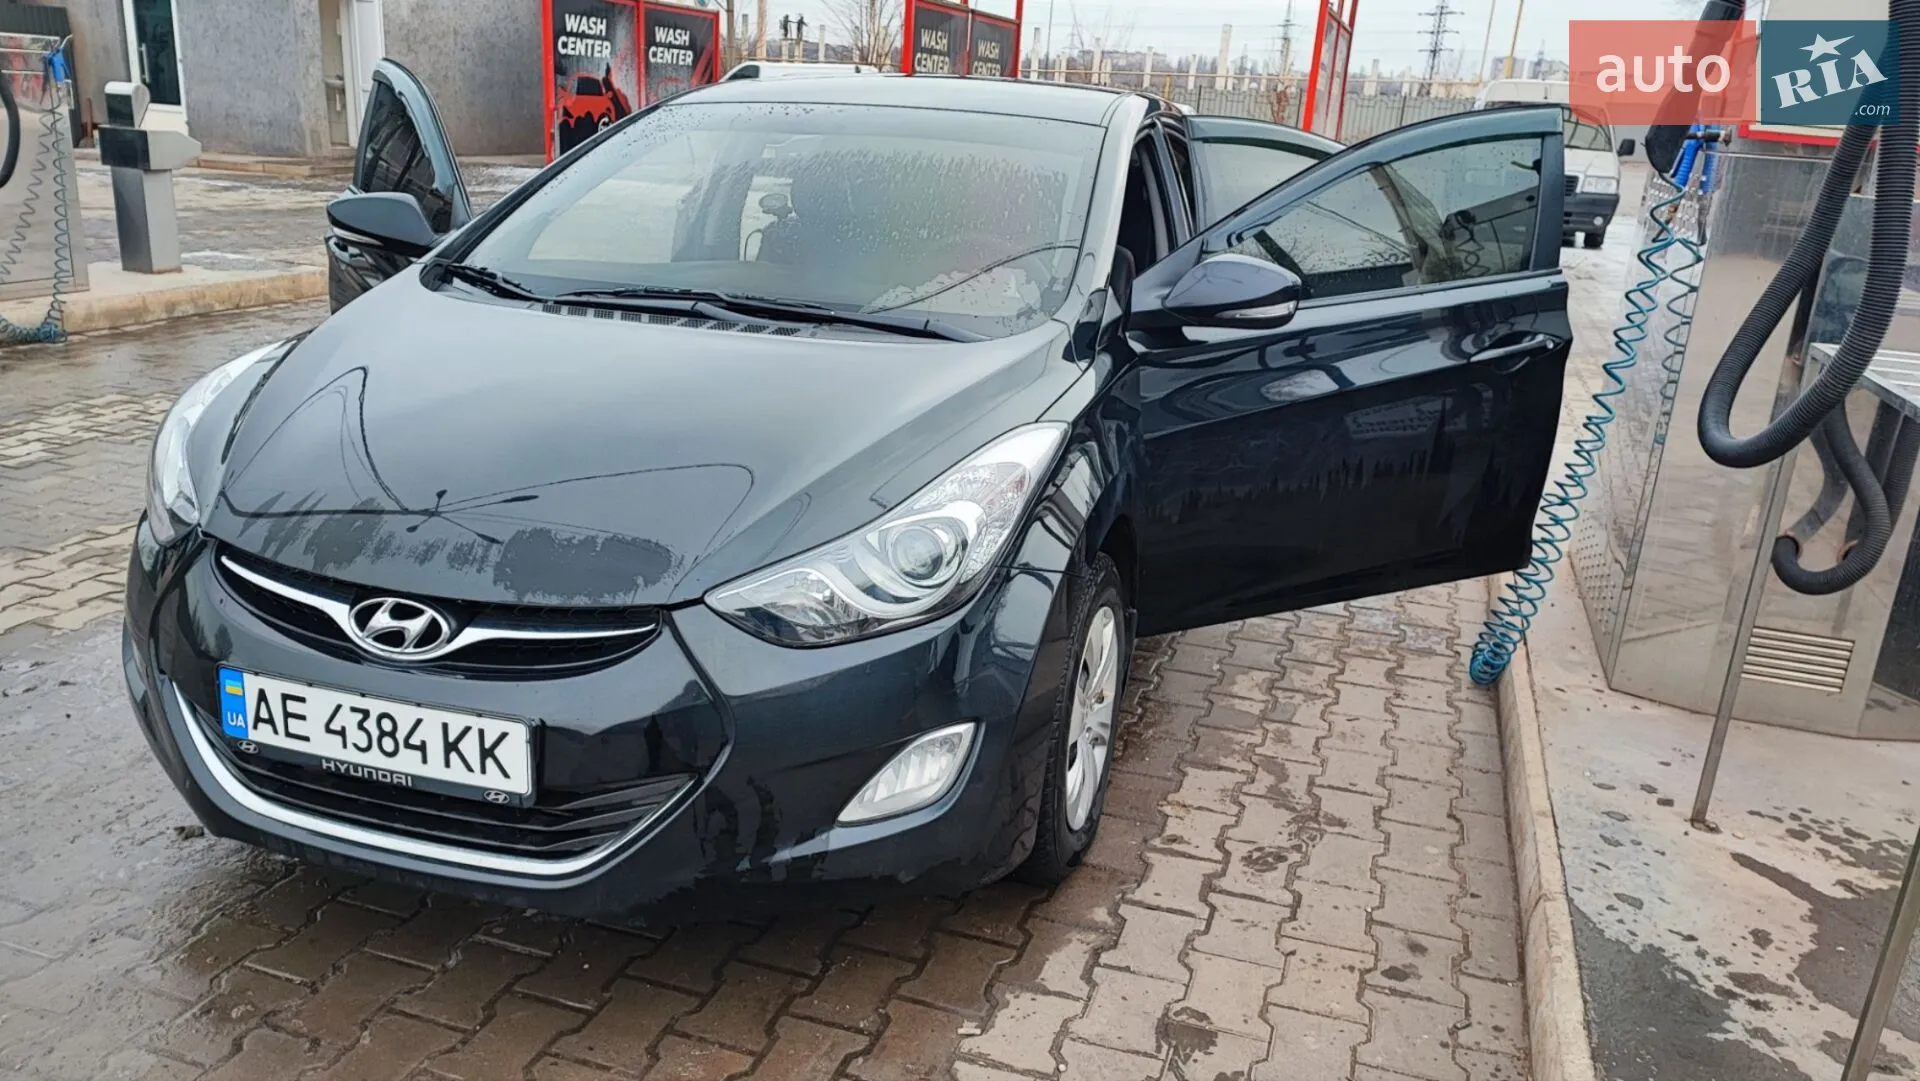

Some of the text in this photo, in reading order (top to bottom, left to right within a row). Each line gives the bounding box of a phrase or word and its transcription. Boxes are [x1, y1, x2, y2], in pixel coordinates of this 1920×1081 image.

[565, 13, 607, 36] WASH
[655, 26, 690, 46] WASH
[921, 28, 948, 51] WASH
[558, 36, 612, 58] CENTER
[649, 46, 694, 66] CENTER
[977, 40, 1000, 59] WASH
[914, 52, 950, 73] CENTER
[972, 61, 1001, 77] CENTER
[227, 711, 246, 729] UA
[252, 688, 511, 779] AE 4384 KK
[321, 758, 413, 787] HYUNDAI
